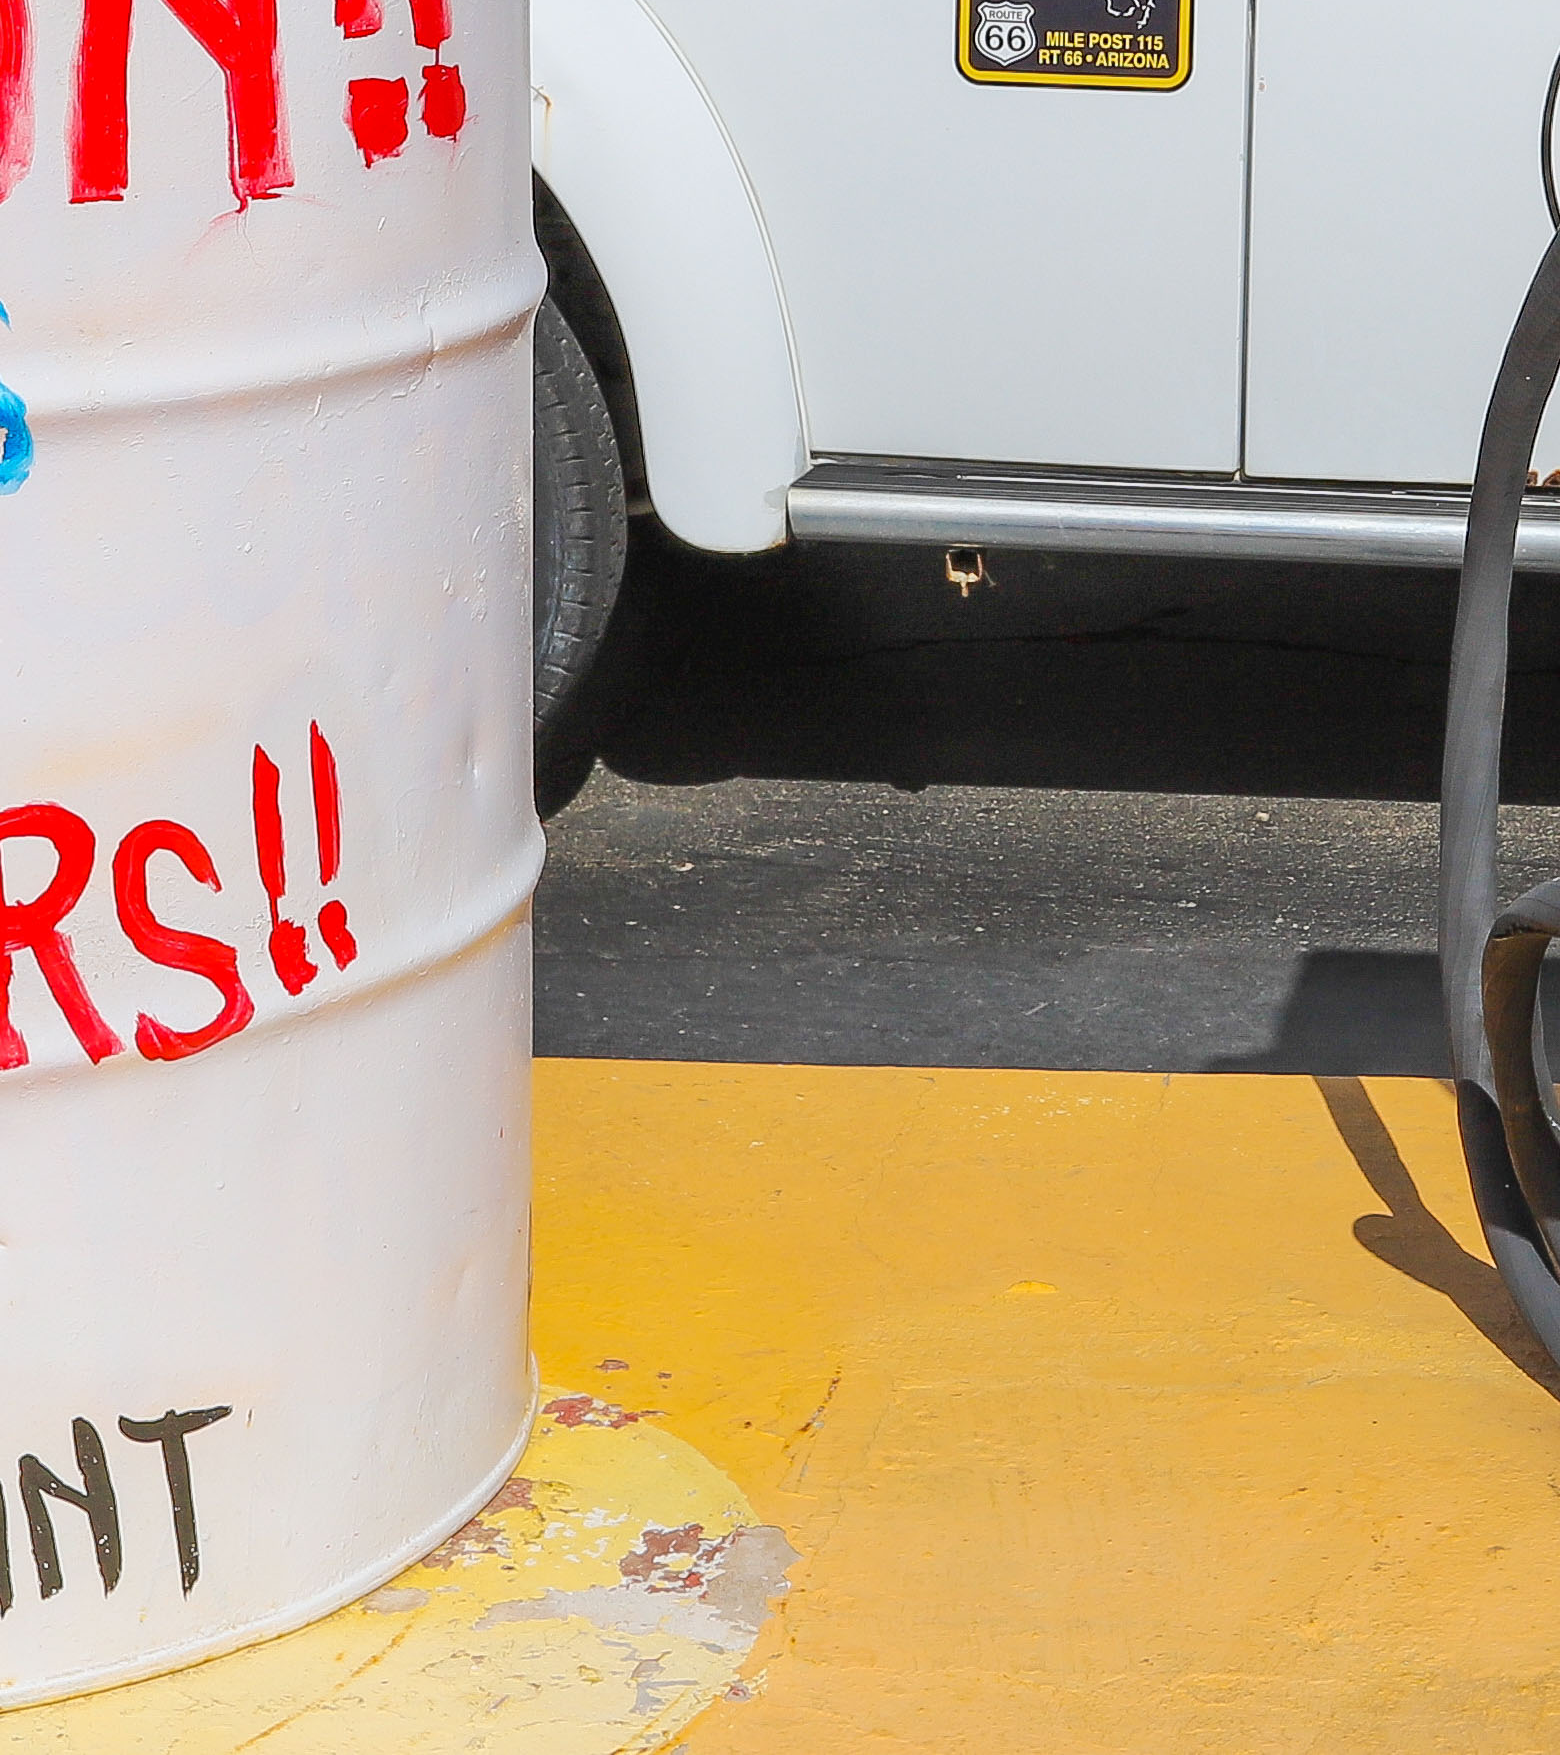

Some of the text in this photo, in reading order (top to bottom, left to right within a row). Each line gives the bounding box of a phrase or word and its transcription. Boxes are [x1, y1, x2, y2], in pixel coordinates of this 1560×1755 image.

[989, 9, 1024, 21] ROUTE
[985, 25, 1027, 52] 66
[1046, 31, 1164, 52] MILE POST 115
[1038, 49, 1062, 65] RT
[1064, 50, 1083, 66] 66
[1095, 52, 1171, 69] ARIZONA
